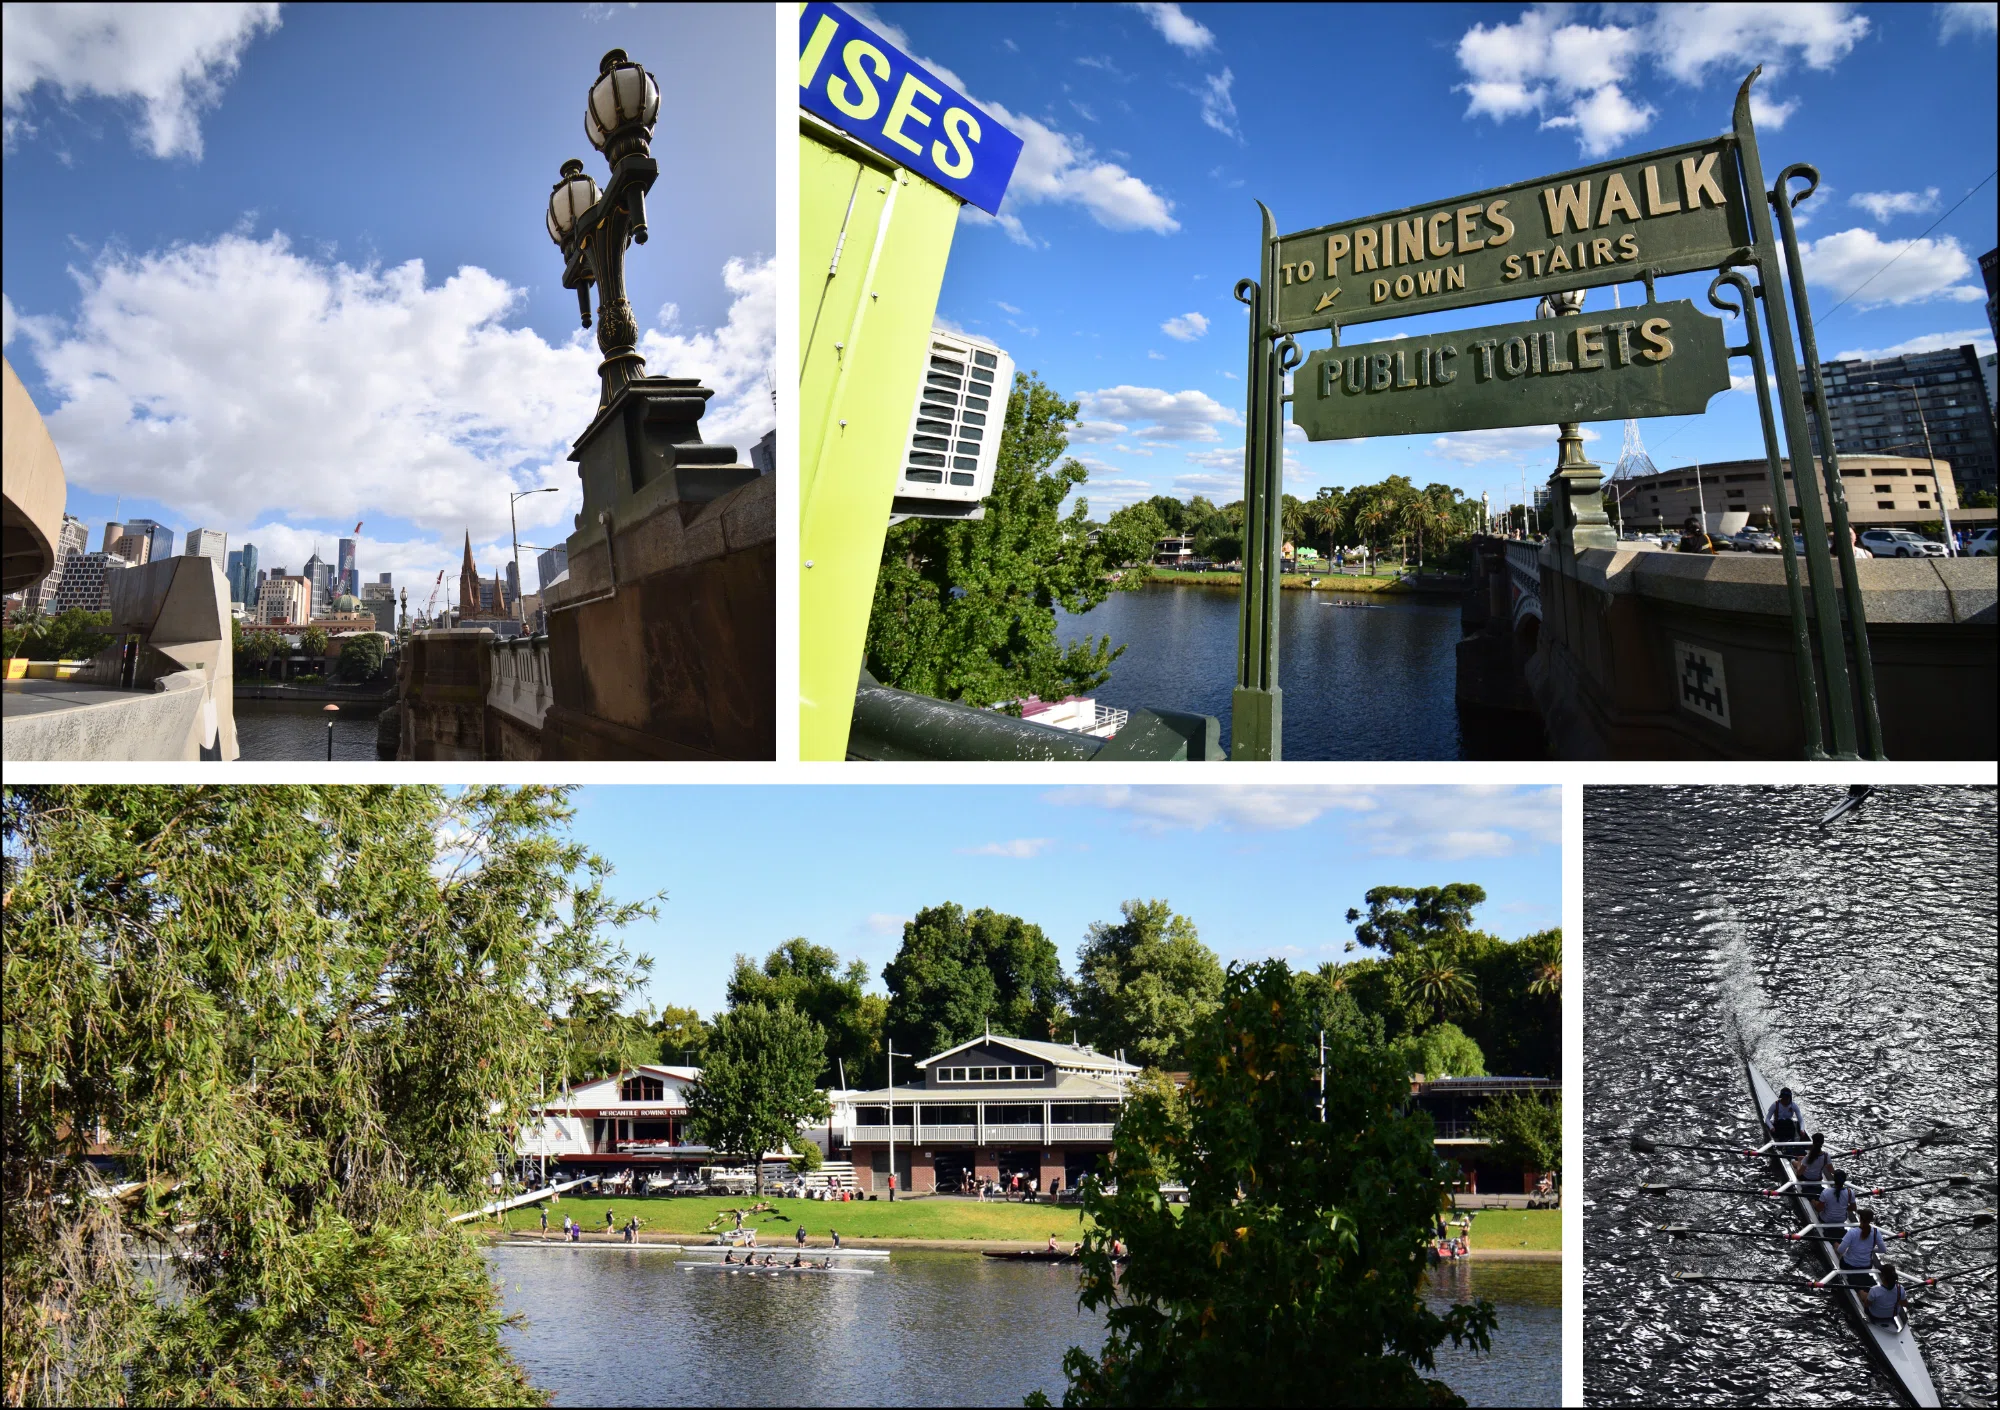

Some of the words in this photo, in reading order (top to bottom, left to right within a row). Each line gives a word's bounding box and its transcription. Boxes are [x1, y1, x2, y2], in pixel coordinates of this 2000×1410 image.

[799, 3, 982, 180] ISES
[1282, 259, 1316, 286] TO
[1326, 199, 1515, 278] PRINCES
[1543, 151, 1728, 235] WALK
[1374, 263, 1466, 303] DOWN
[1504, 233, 1639, 280] STAIRS
[1321, 344, 1458, 398] PUBLIC
[1474, 317, 1674, 381] TOILETS
